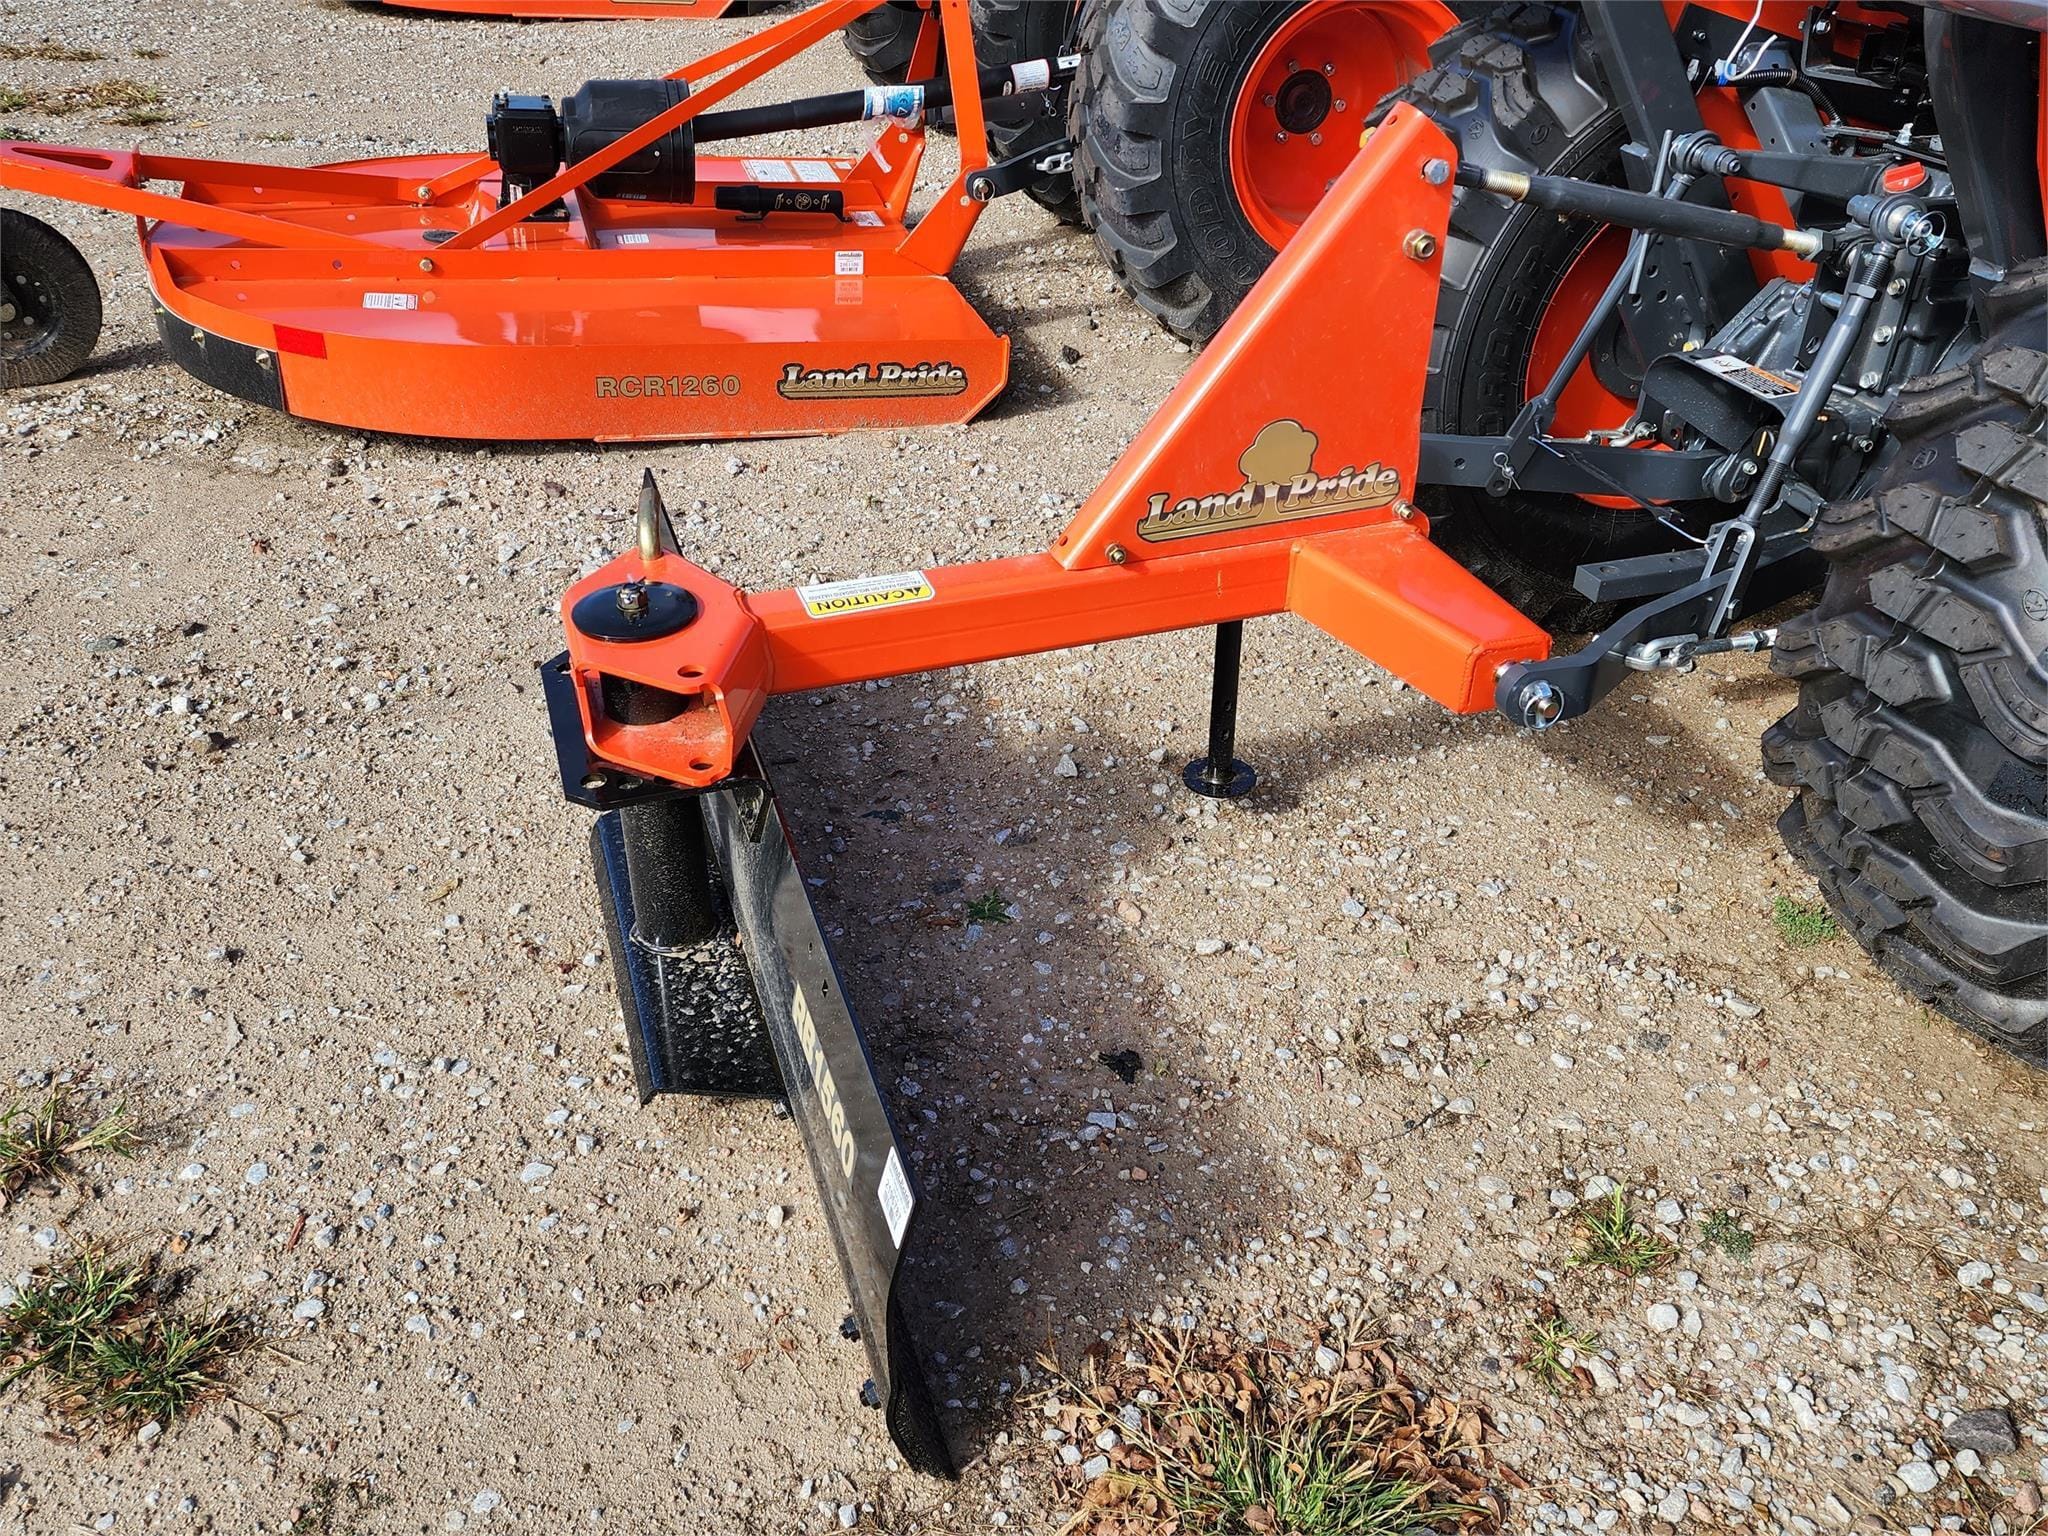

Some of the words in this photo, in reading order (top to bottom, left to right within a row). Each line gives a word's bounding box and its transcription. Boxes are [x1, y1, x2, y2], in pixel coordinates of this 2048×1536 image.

[596, 374, 742, 398] RCR1260
[782, 363, 870, 390] Land
[877, 361, 965, 388] Pride
[1143, 480, 1259, 530] Land
[1284, 462, 1400, 508] Pride
[817, 589, 905, 611] CAUTION
[792, 982, 856, 1179] RB1560
